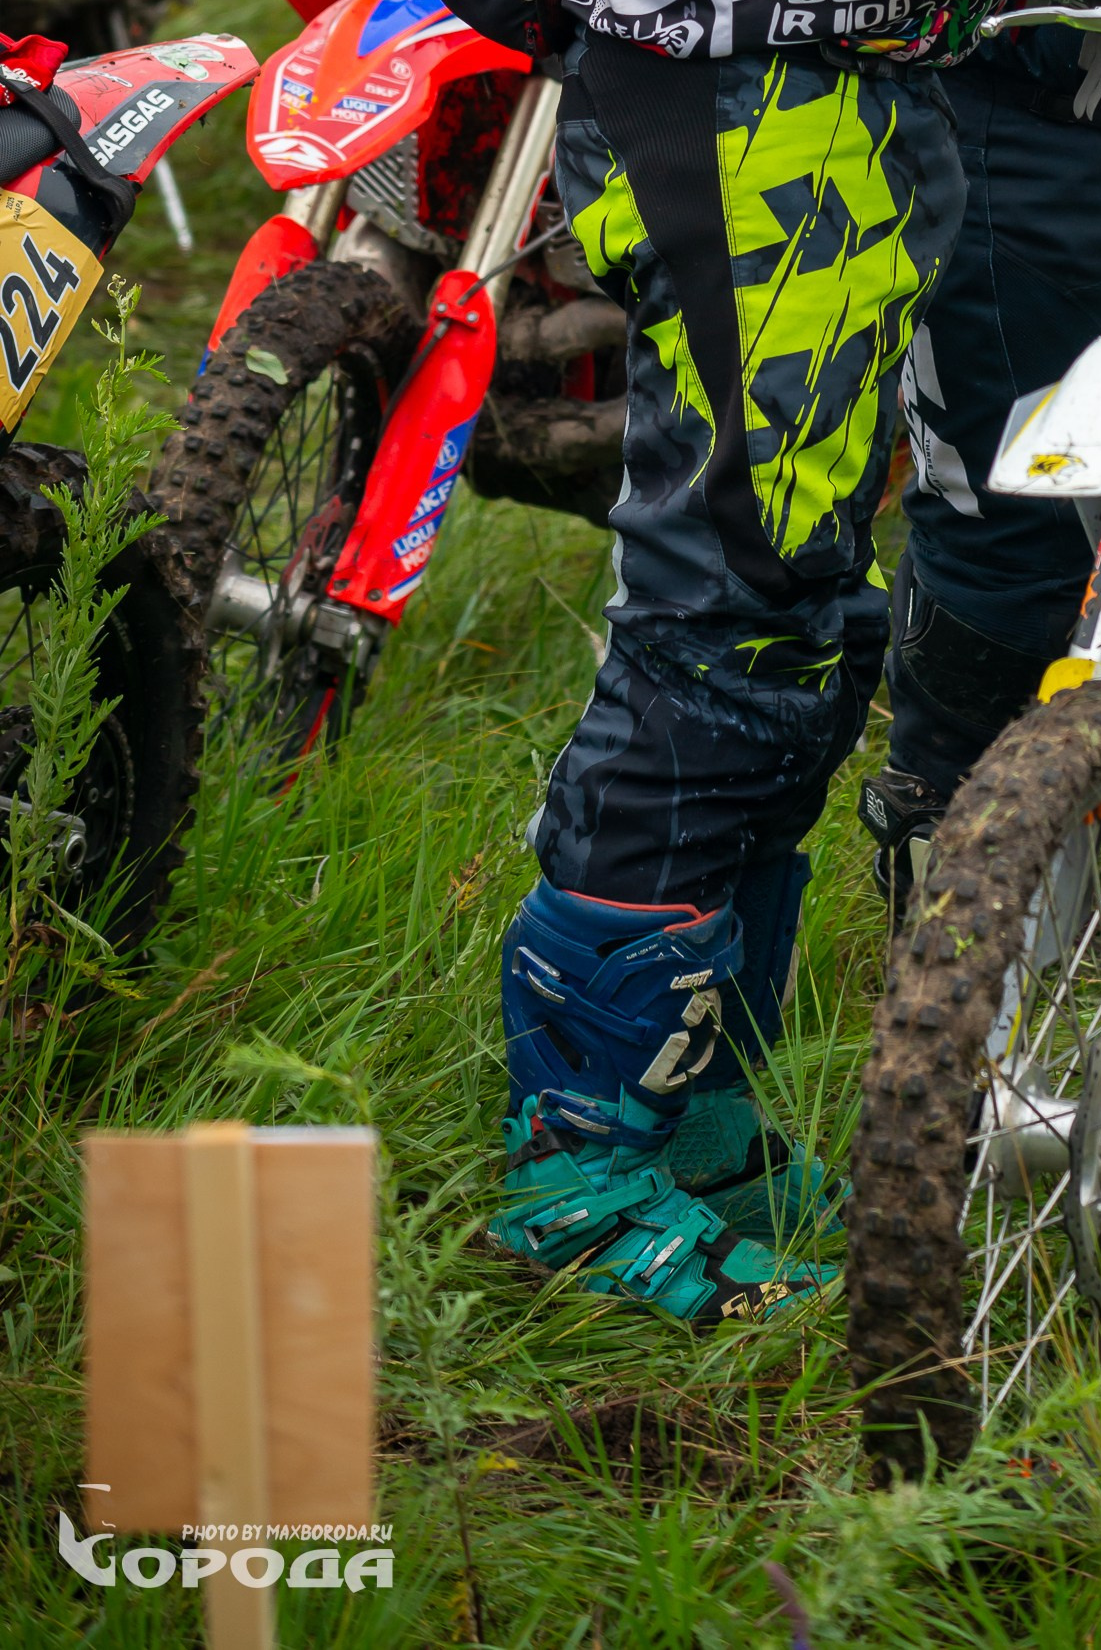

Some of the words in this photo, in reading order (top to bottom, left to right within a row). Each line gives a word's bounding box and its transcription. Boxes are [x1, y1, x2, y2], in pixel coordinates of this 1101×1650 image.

[330, 108, 367, 122] MOLY
[342, 99, 378, 113] LIQUI
[0, 232, 81, 393] 224
[393, 520, 436, 558] LIQUI
[669, 968, 714, 990] LEATT
